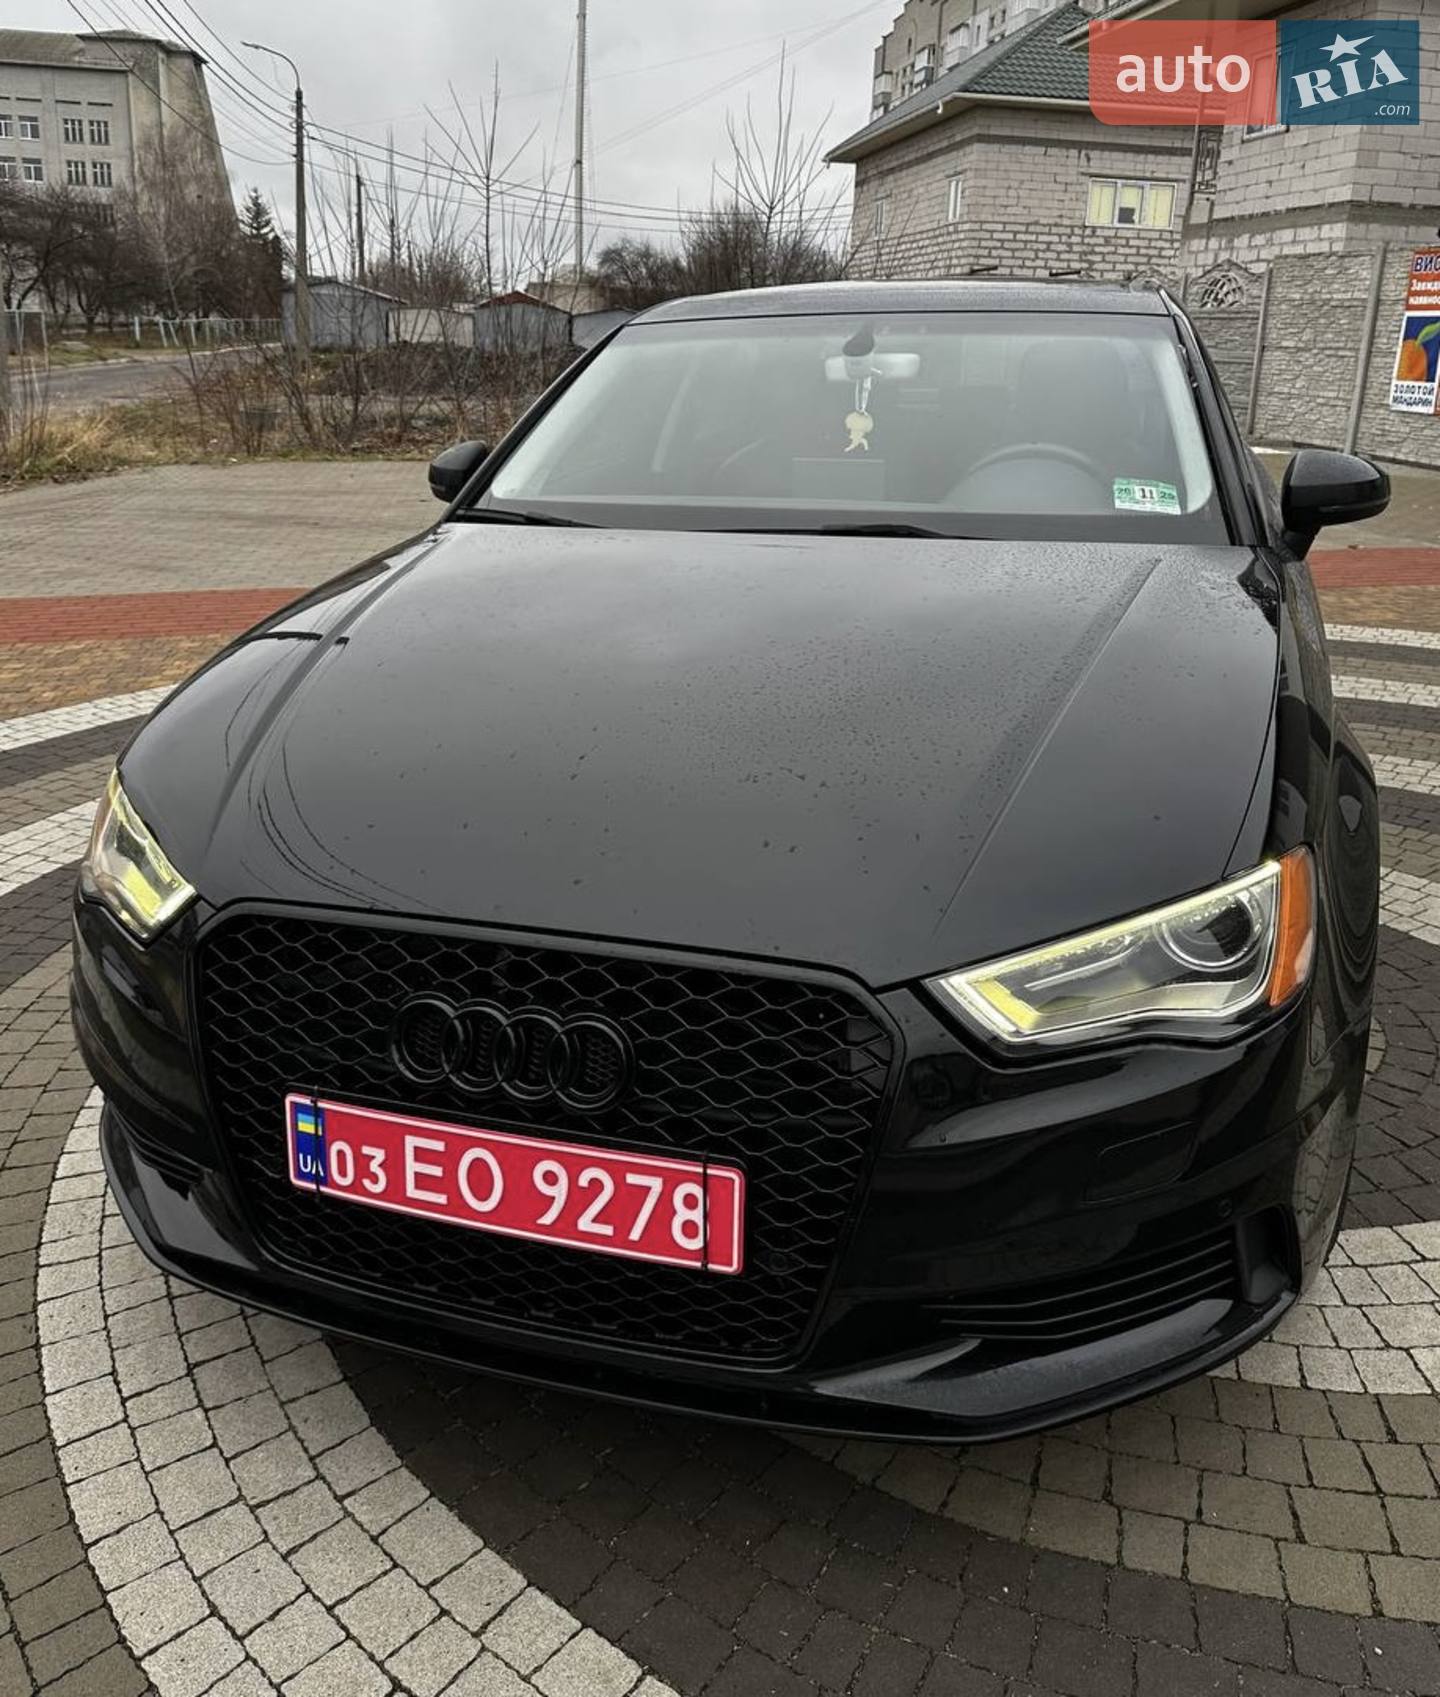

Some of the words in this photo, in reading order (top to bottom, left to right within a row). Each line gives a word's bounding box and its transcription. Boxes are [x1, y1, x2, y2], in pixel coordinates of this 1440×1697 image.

[1393, 383, 1435, 396] ЗОЛОТОЙ
[1391, 395, 1433, 407] МАНДАРИН
[1138, 487, 1155, 500] 11
[298, 1152, 324, 1177] UA
[329, 1140, 387, 1194] 03
[404, 1135, 504, 1213] EO
[532, 1159, 710, 1251] 9278
